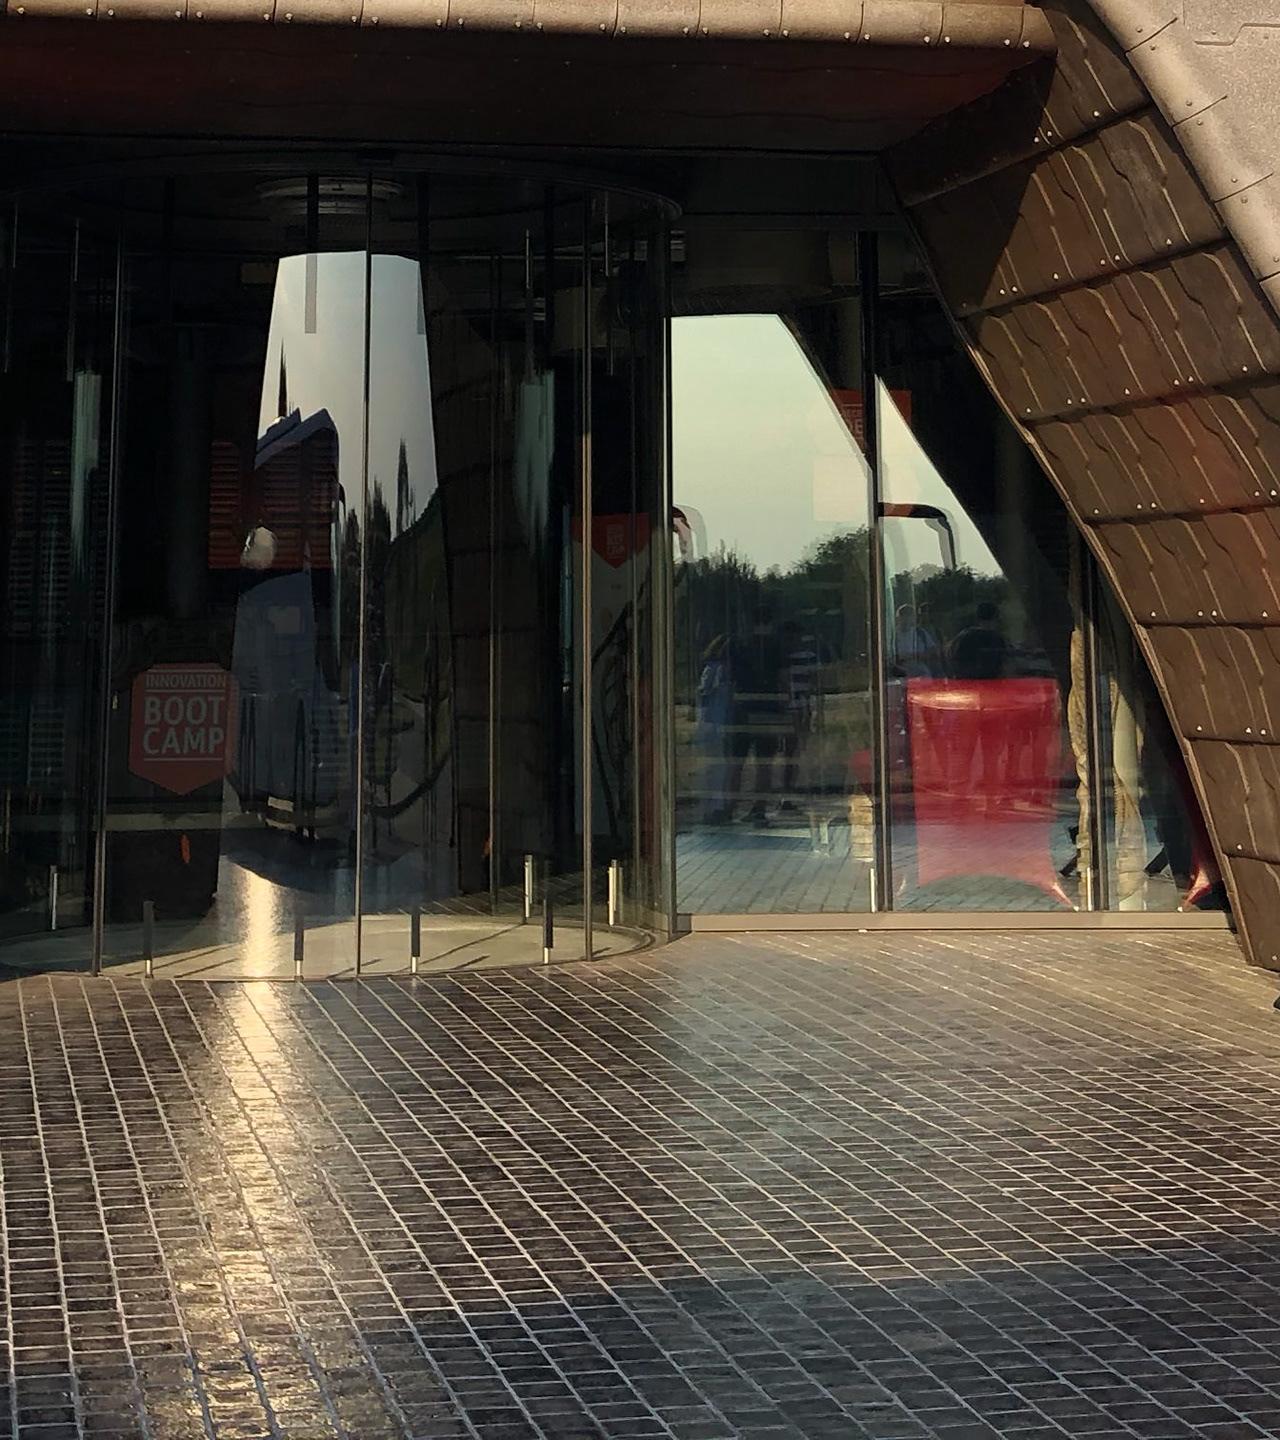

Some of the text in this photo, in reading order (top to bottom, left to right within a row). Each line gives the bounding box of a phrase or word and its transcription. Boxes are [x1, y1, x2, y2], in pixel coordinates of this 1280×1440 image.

[146, 674, 226, 688] INNOVATION
[145, 696, 225, 725] BOOT
[143, 727, 224, 755] CAMP
